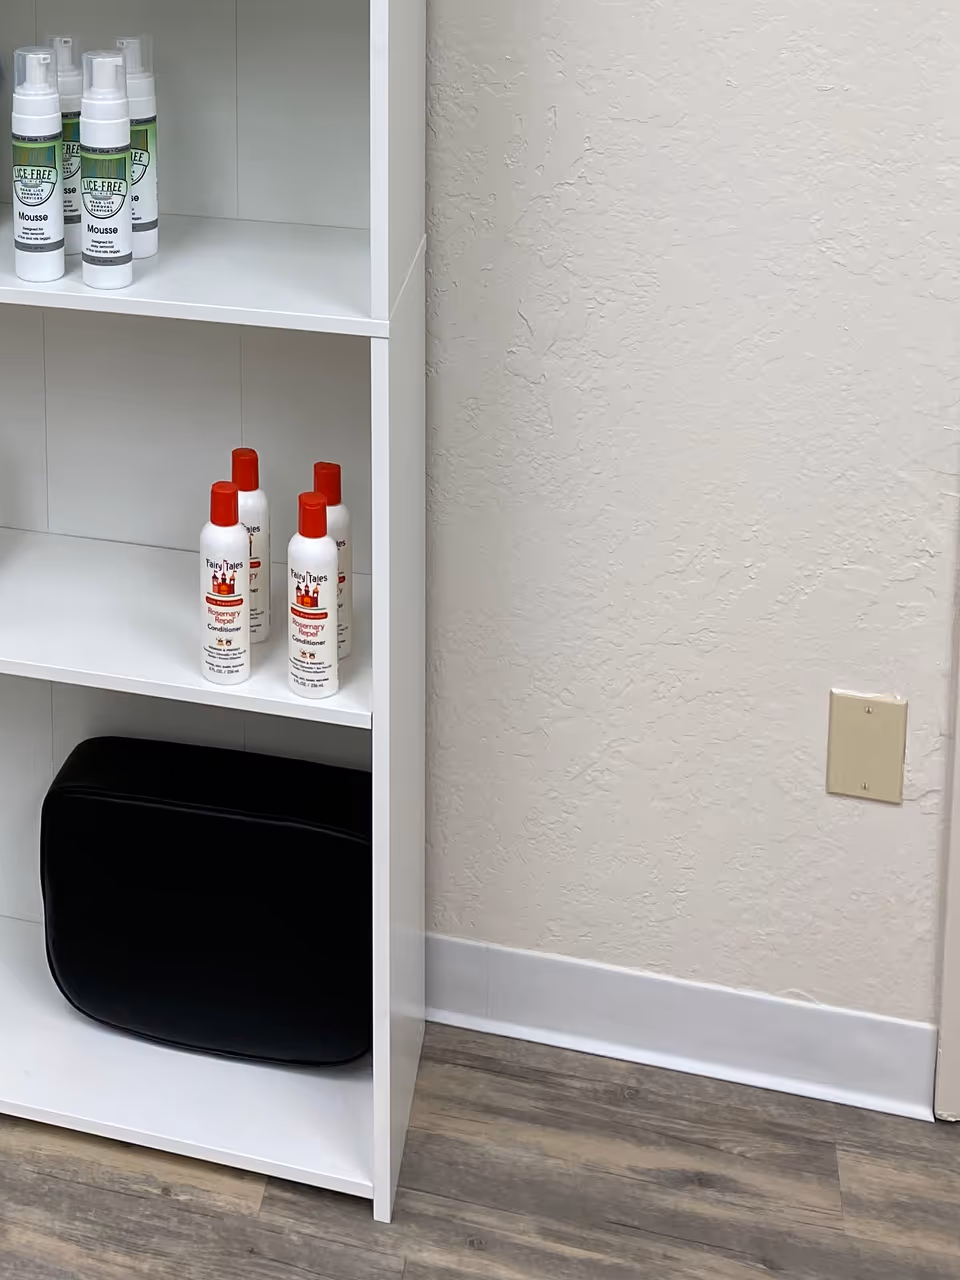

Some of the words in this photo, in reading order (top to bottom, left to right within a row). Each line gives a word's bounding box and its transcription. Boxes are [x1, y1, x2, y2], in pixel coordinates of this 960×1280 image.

[14, 168, 52, 180] LICE-FREE
[83, 180, 123, 192] LICE-FREE
[19, 211, 48, 222] Mousse
[87, 224, 118, 234] Mousse
[206, 558, 222, 571] Fairy
[225, 562, 243, 571] Tales
[291, 568, 305, 582] Fairy
[309, 575, 327, 583] Tales
[208, 607, 240, 617] Rosemary
[207, 623, 241, 632] Conditioner
[292, 617, 325, 631] Rosemary
[292, 635, 326, 646] Conditioner
